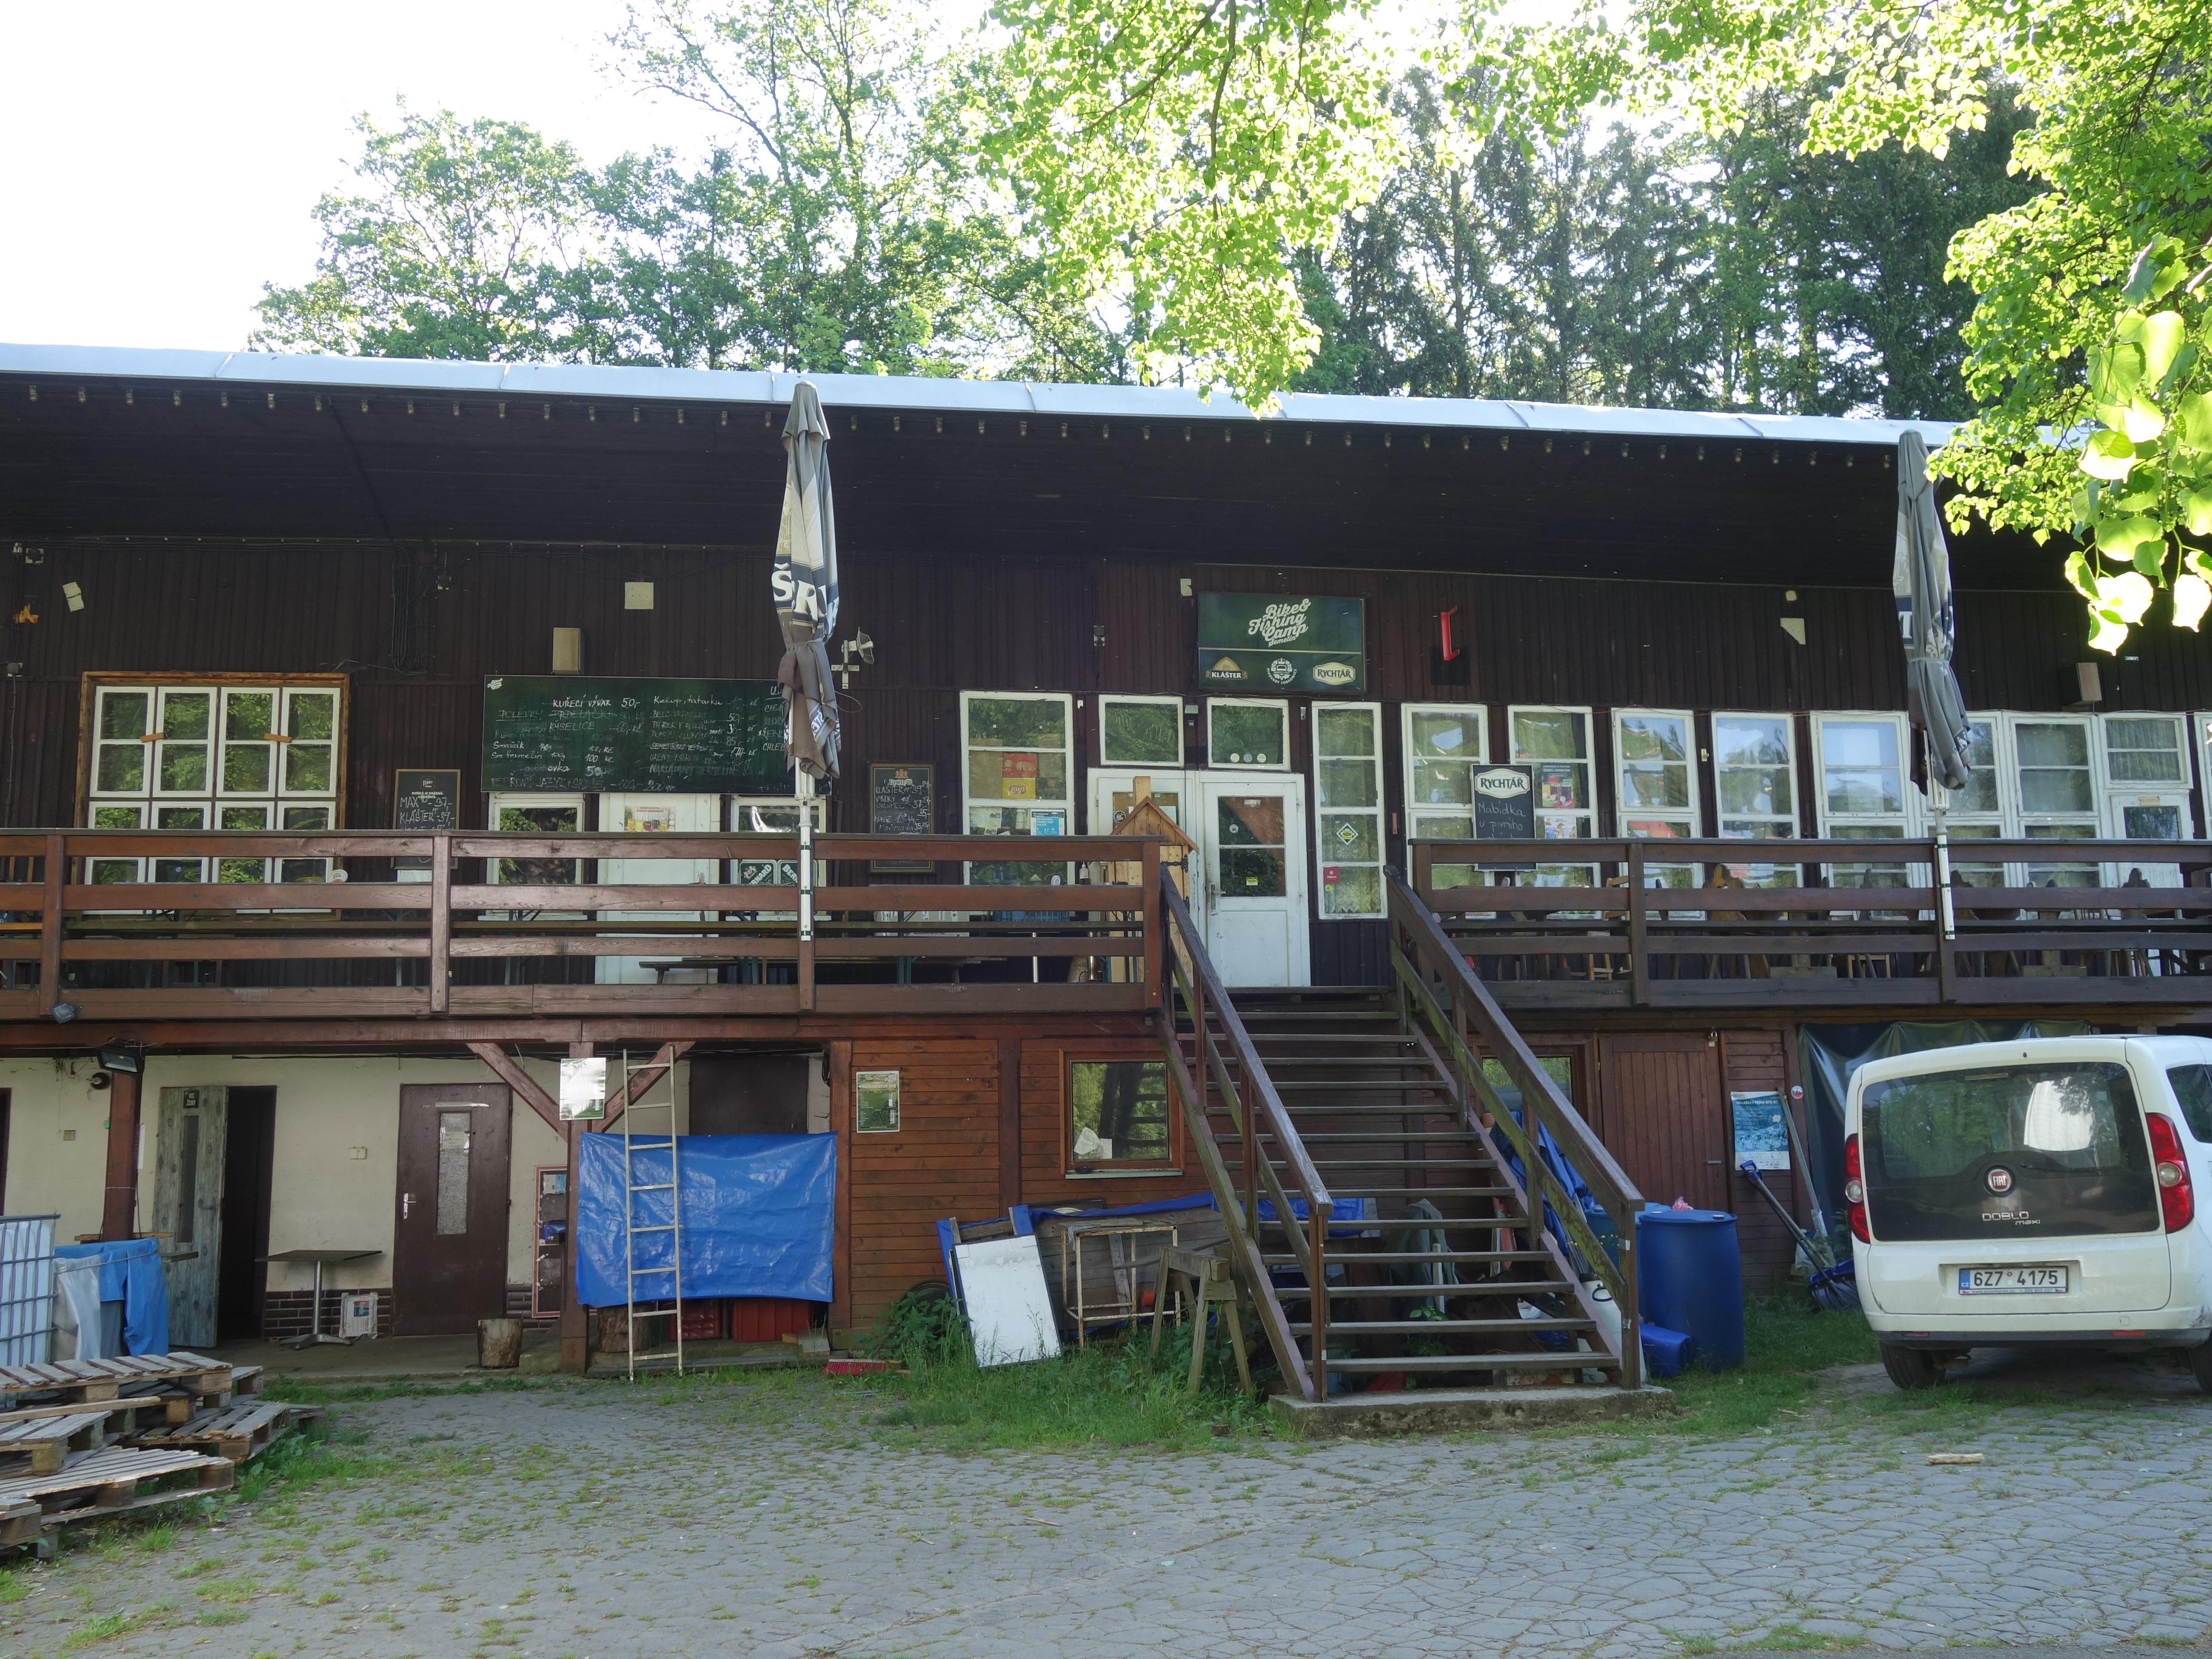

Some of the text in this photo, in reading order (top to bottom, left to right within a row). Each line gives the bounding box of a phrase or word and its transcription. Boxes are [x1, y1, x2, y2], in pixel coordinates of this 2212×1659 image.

[1263, 598, 1312, 619] Bike&
[1248, 613, 1307, 635] Fishing
[1262, 623, 1309, 641] Camp
[1212, 670, 1242, 679] KLÁŠTER
[1318, 668, 1352, 678] RYCHTÁŘ
[553, 694, 587, 708] KUŘECÍ
[588, 695, 611, 708] VÝVAR
[1480, 776, 1526, 790] RYCHTÁŘ
[400, 796, 419, 808] MAX
[1478, 800, 1526, 817] Nabídka
[400, 809, 434, 824] KLÁŠTER
[1489, 816, 1523, 833] pivního
[748, 864, 772, 885] RNARD
[1992, 1175, 2006, 1186] FIAT
[1982, 1211, 2029, 1221] DOBLO
[1974, 1270, 2058, 1287] 6Z7 4175
